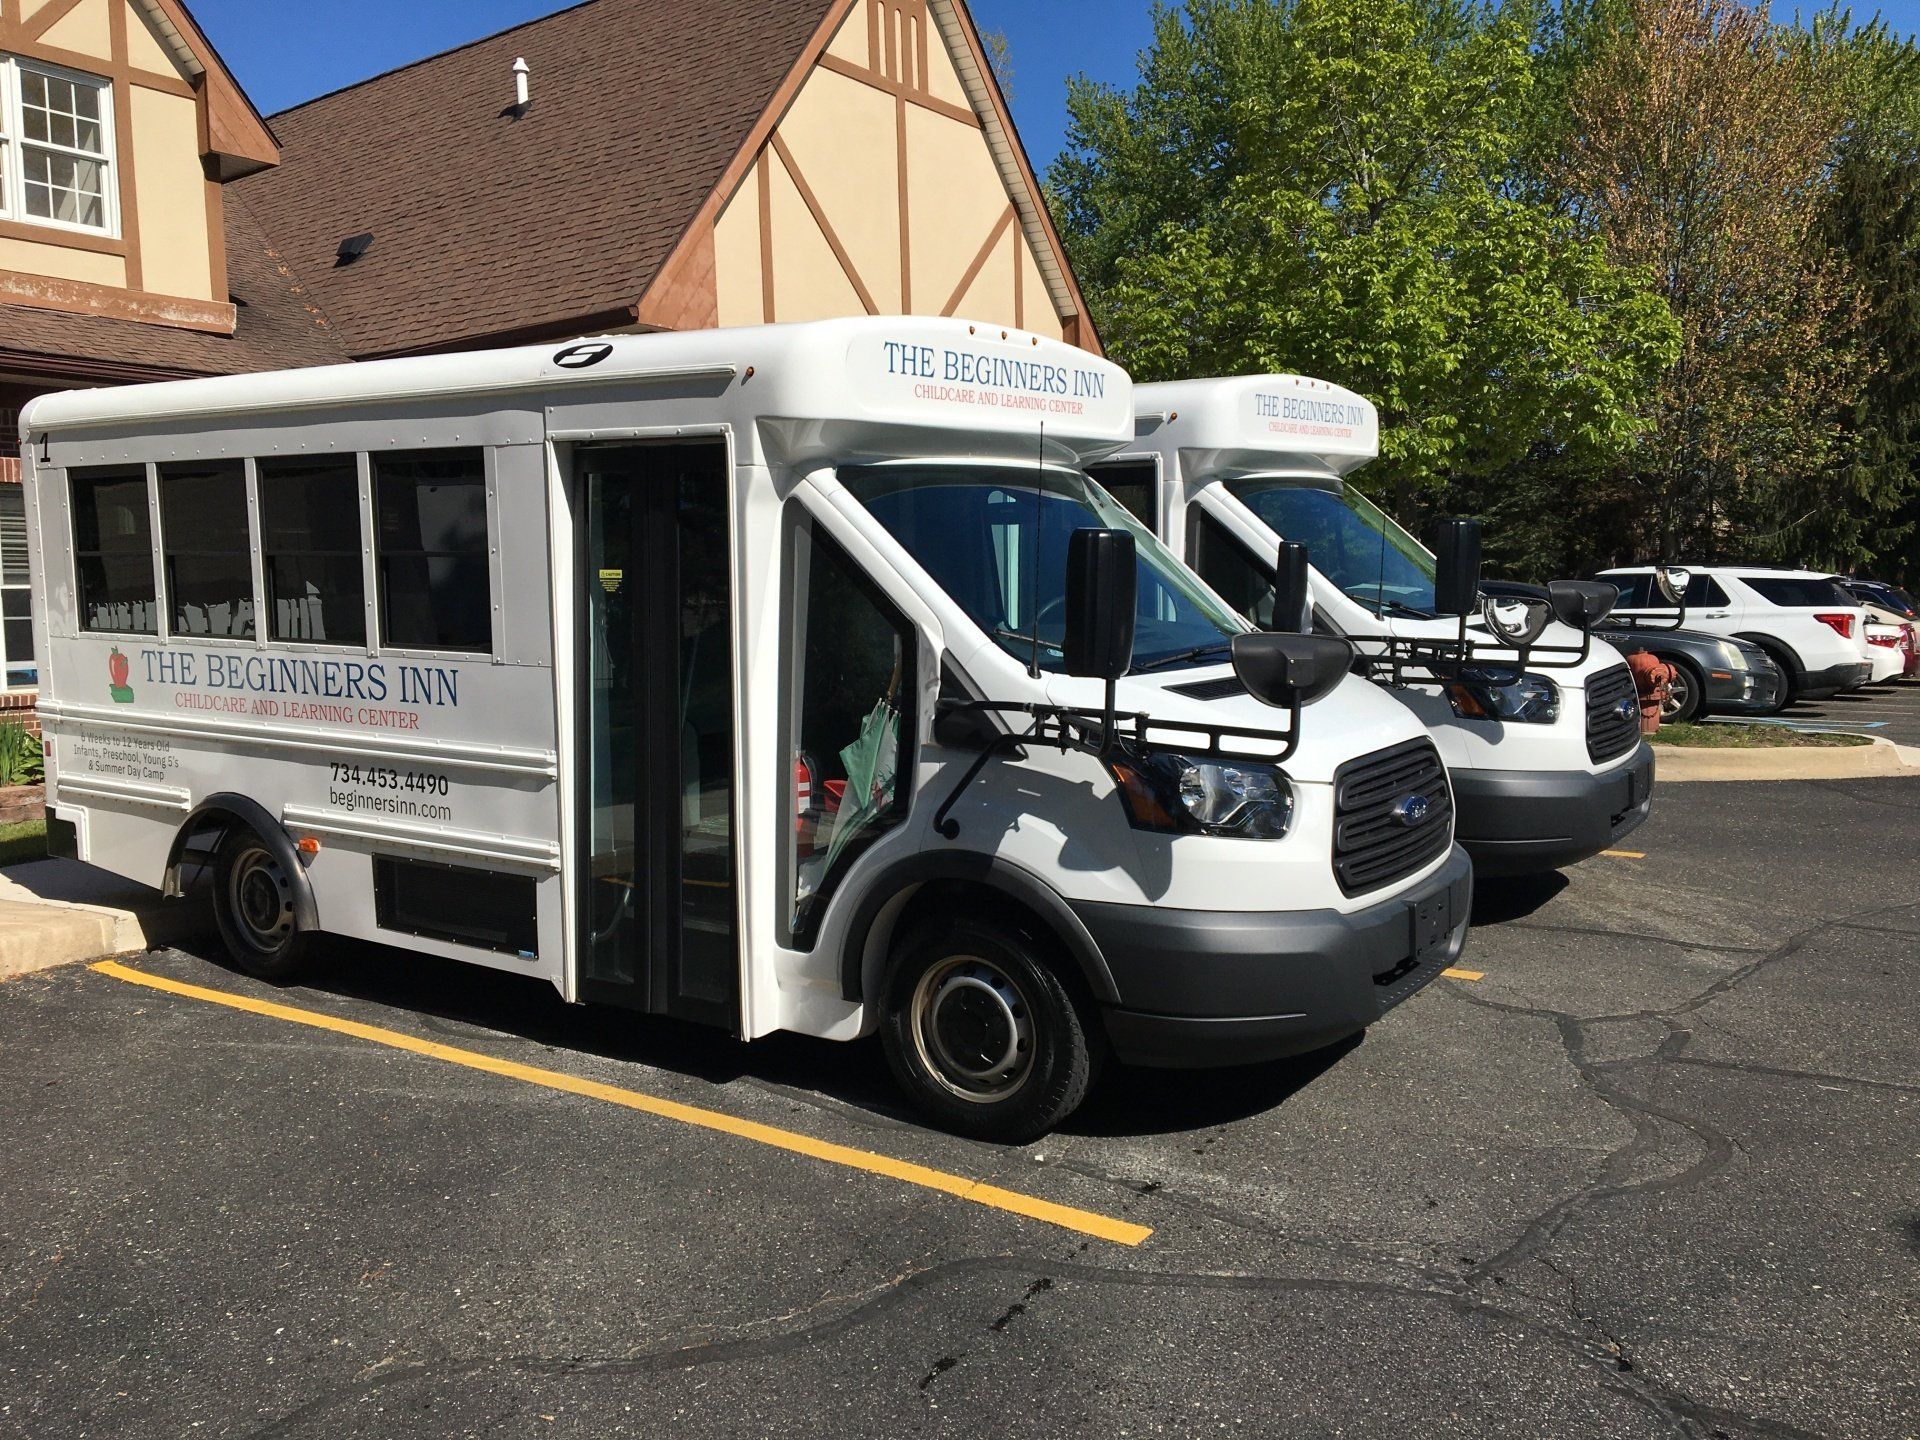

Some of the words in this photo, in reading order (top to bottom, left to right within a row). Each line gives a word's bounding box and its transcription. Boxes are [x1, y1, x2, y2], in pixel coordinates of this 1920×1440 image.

[884, 341, 936, 378] THE
[943, 350, 1067, 395] BEGINNERS
[1073, 370, 1105, 399] INN
[914, 384, 975, 404] CHILDCARE
[978, 393, 998, 406] AND
[1001, 394, 1047, 411] LEARNING
[1048, 399, 1083, 415] CENTER
[1255, 393, 1279, 417] THE
[1282, 397, 1344, 424] BEGINNERS
[1347, 405, 1364, 426] INN
[40, 432, 51, 463] 1
[141, 650, 197, 686] THE
[205, 654, 387, 701] BEGINNERS
[398, 666, 459, 707] INN
[175, 692, 247, 714] CHILDCARE
[251, 699, 279, 716] AND
[283, 701, 353, 724] LEARNING
[358, 708, 420, 730] CENTER
[73, 744, 102, 759] Infants,
[102, 748, 141, 764] Preschool,
[142, 753, 167, 769] Young
[168, 755, 179, 768] 5's
[81, 731, 86, 742] 6
[86, 732, 111, 746] Weeks
[112, 735, 120, 746] to
[122, 736, 132, 748] 12
[133, 738, 155, 750] Years
[156, 740, 170, 752] Old
[88, 759, 94, 771] &
[95, 760, 126, 775] Summer
[127, 764, 141, 780] Day
[142, 767, 165, 782] Camp
[330, 762, 449, 796] 734.453.4490
[329, 786, 451, 821] beginnersinn.com
